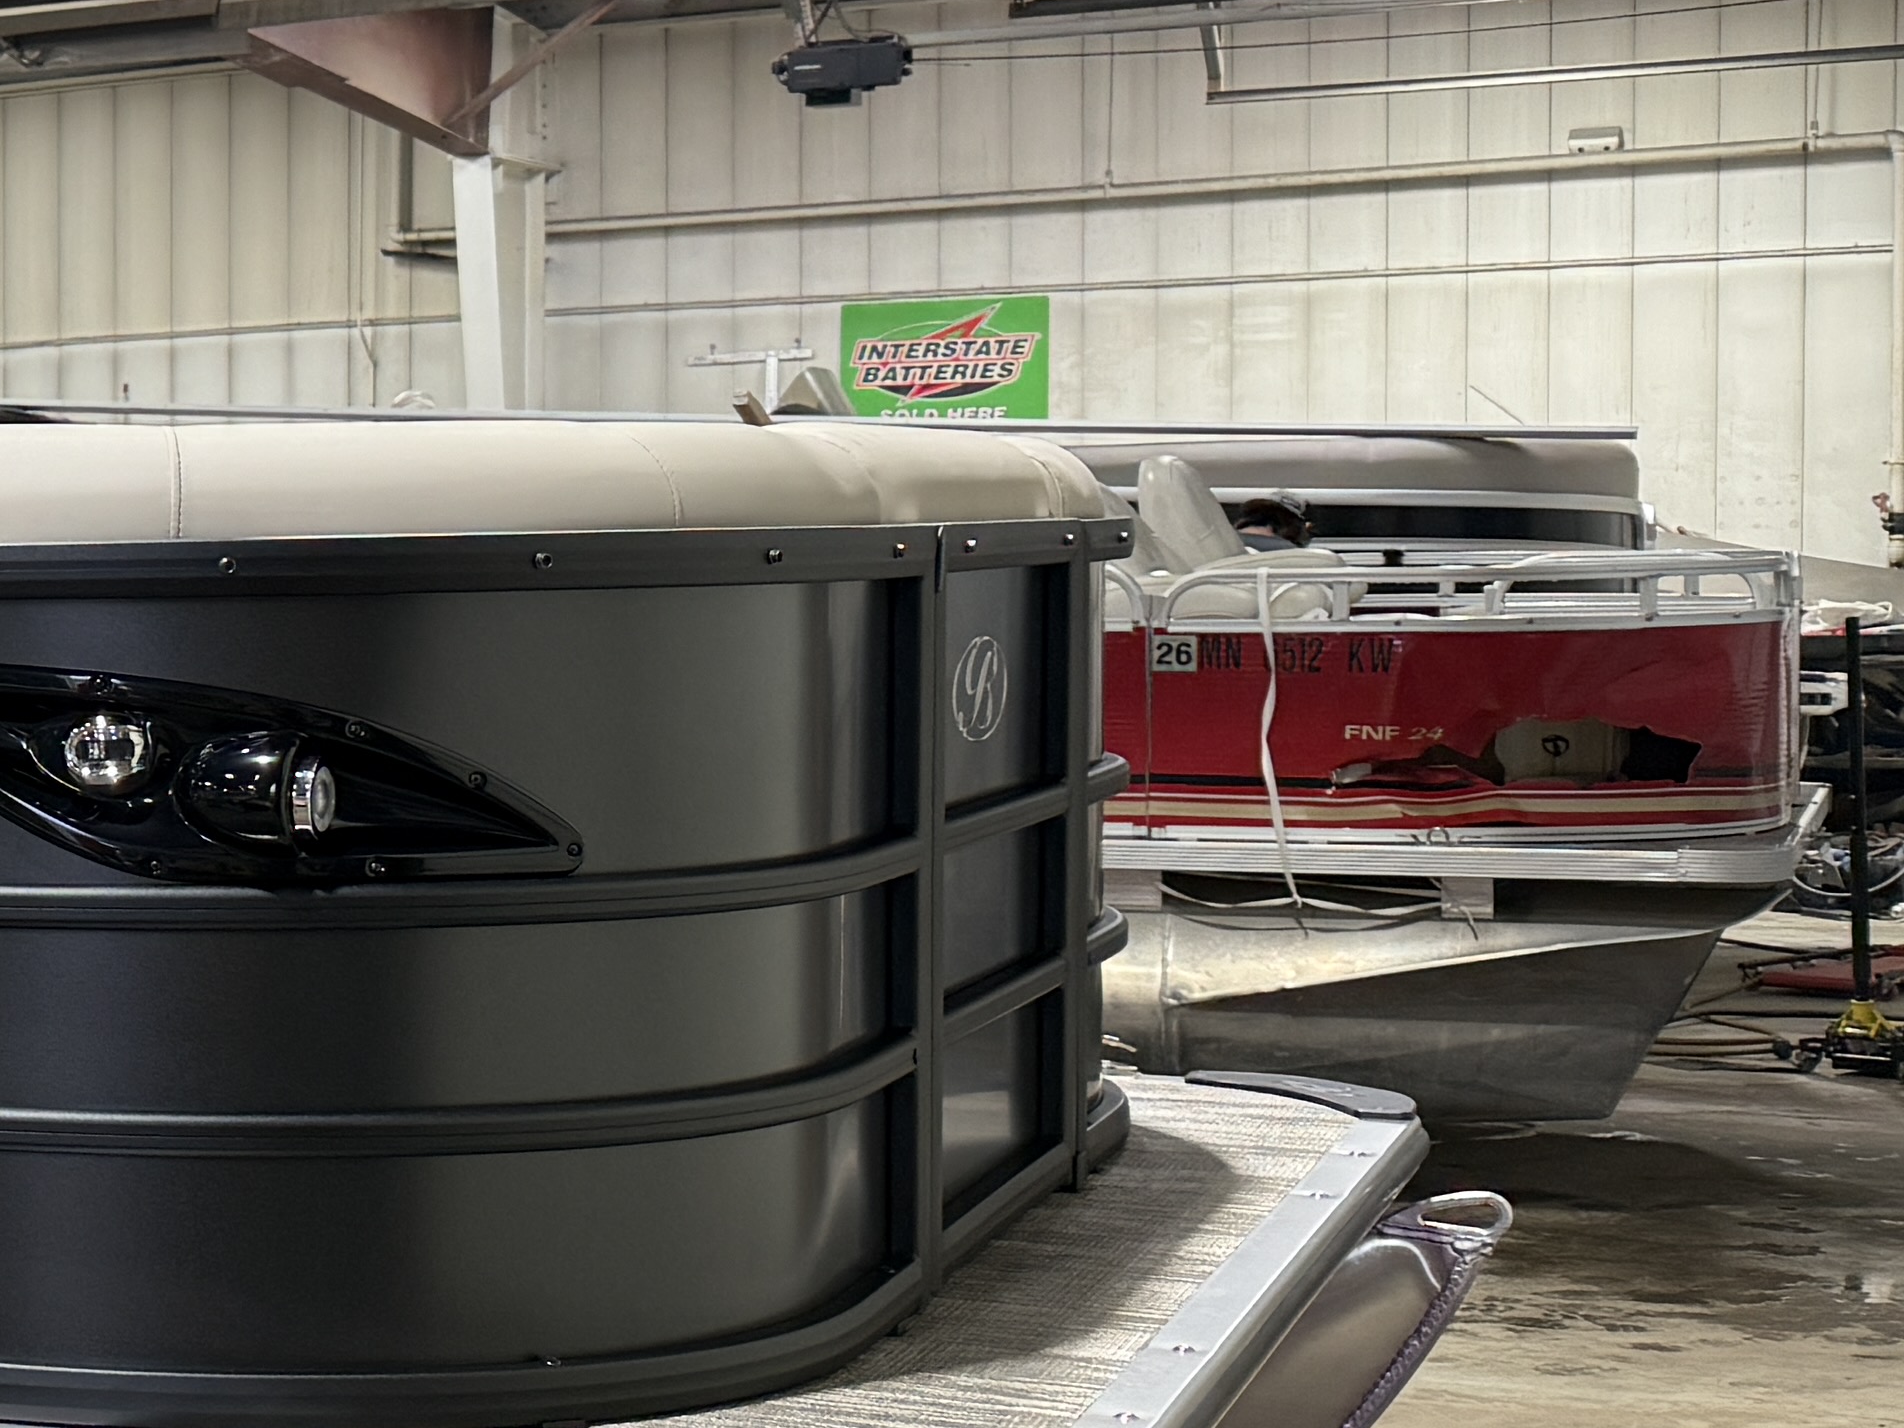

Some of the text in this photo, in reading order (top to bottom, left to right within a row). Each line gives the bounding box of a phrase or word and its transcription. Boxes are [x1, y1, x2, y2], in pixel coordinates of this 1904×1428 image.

[857, 338, 1029, 361] INTERSTATE
[862, 361, 1015, 383] BATTERIES
[1156, 641, 1192, 666] 26
[1200, 636, 1242, 669] MN
[1348, 637, 1392, 673] KW
[1344, 724, 1401, 740] FNF
